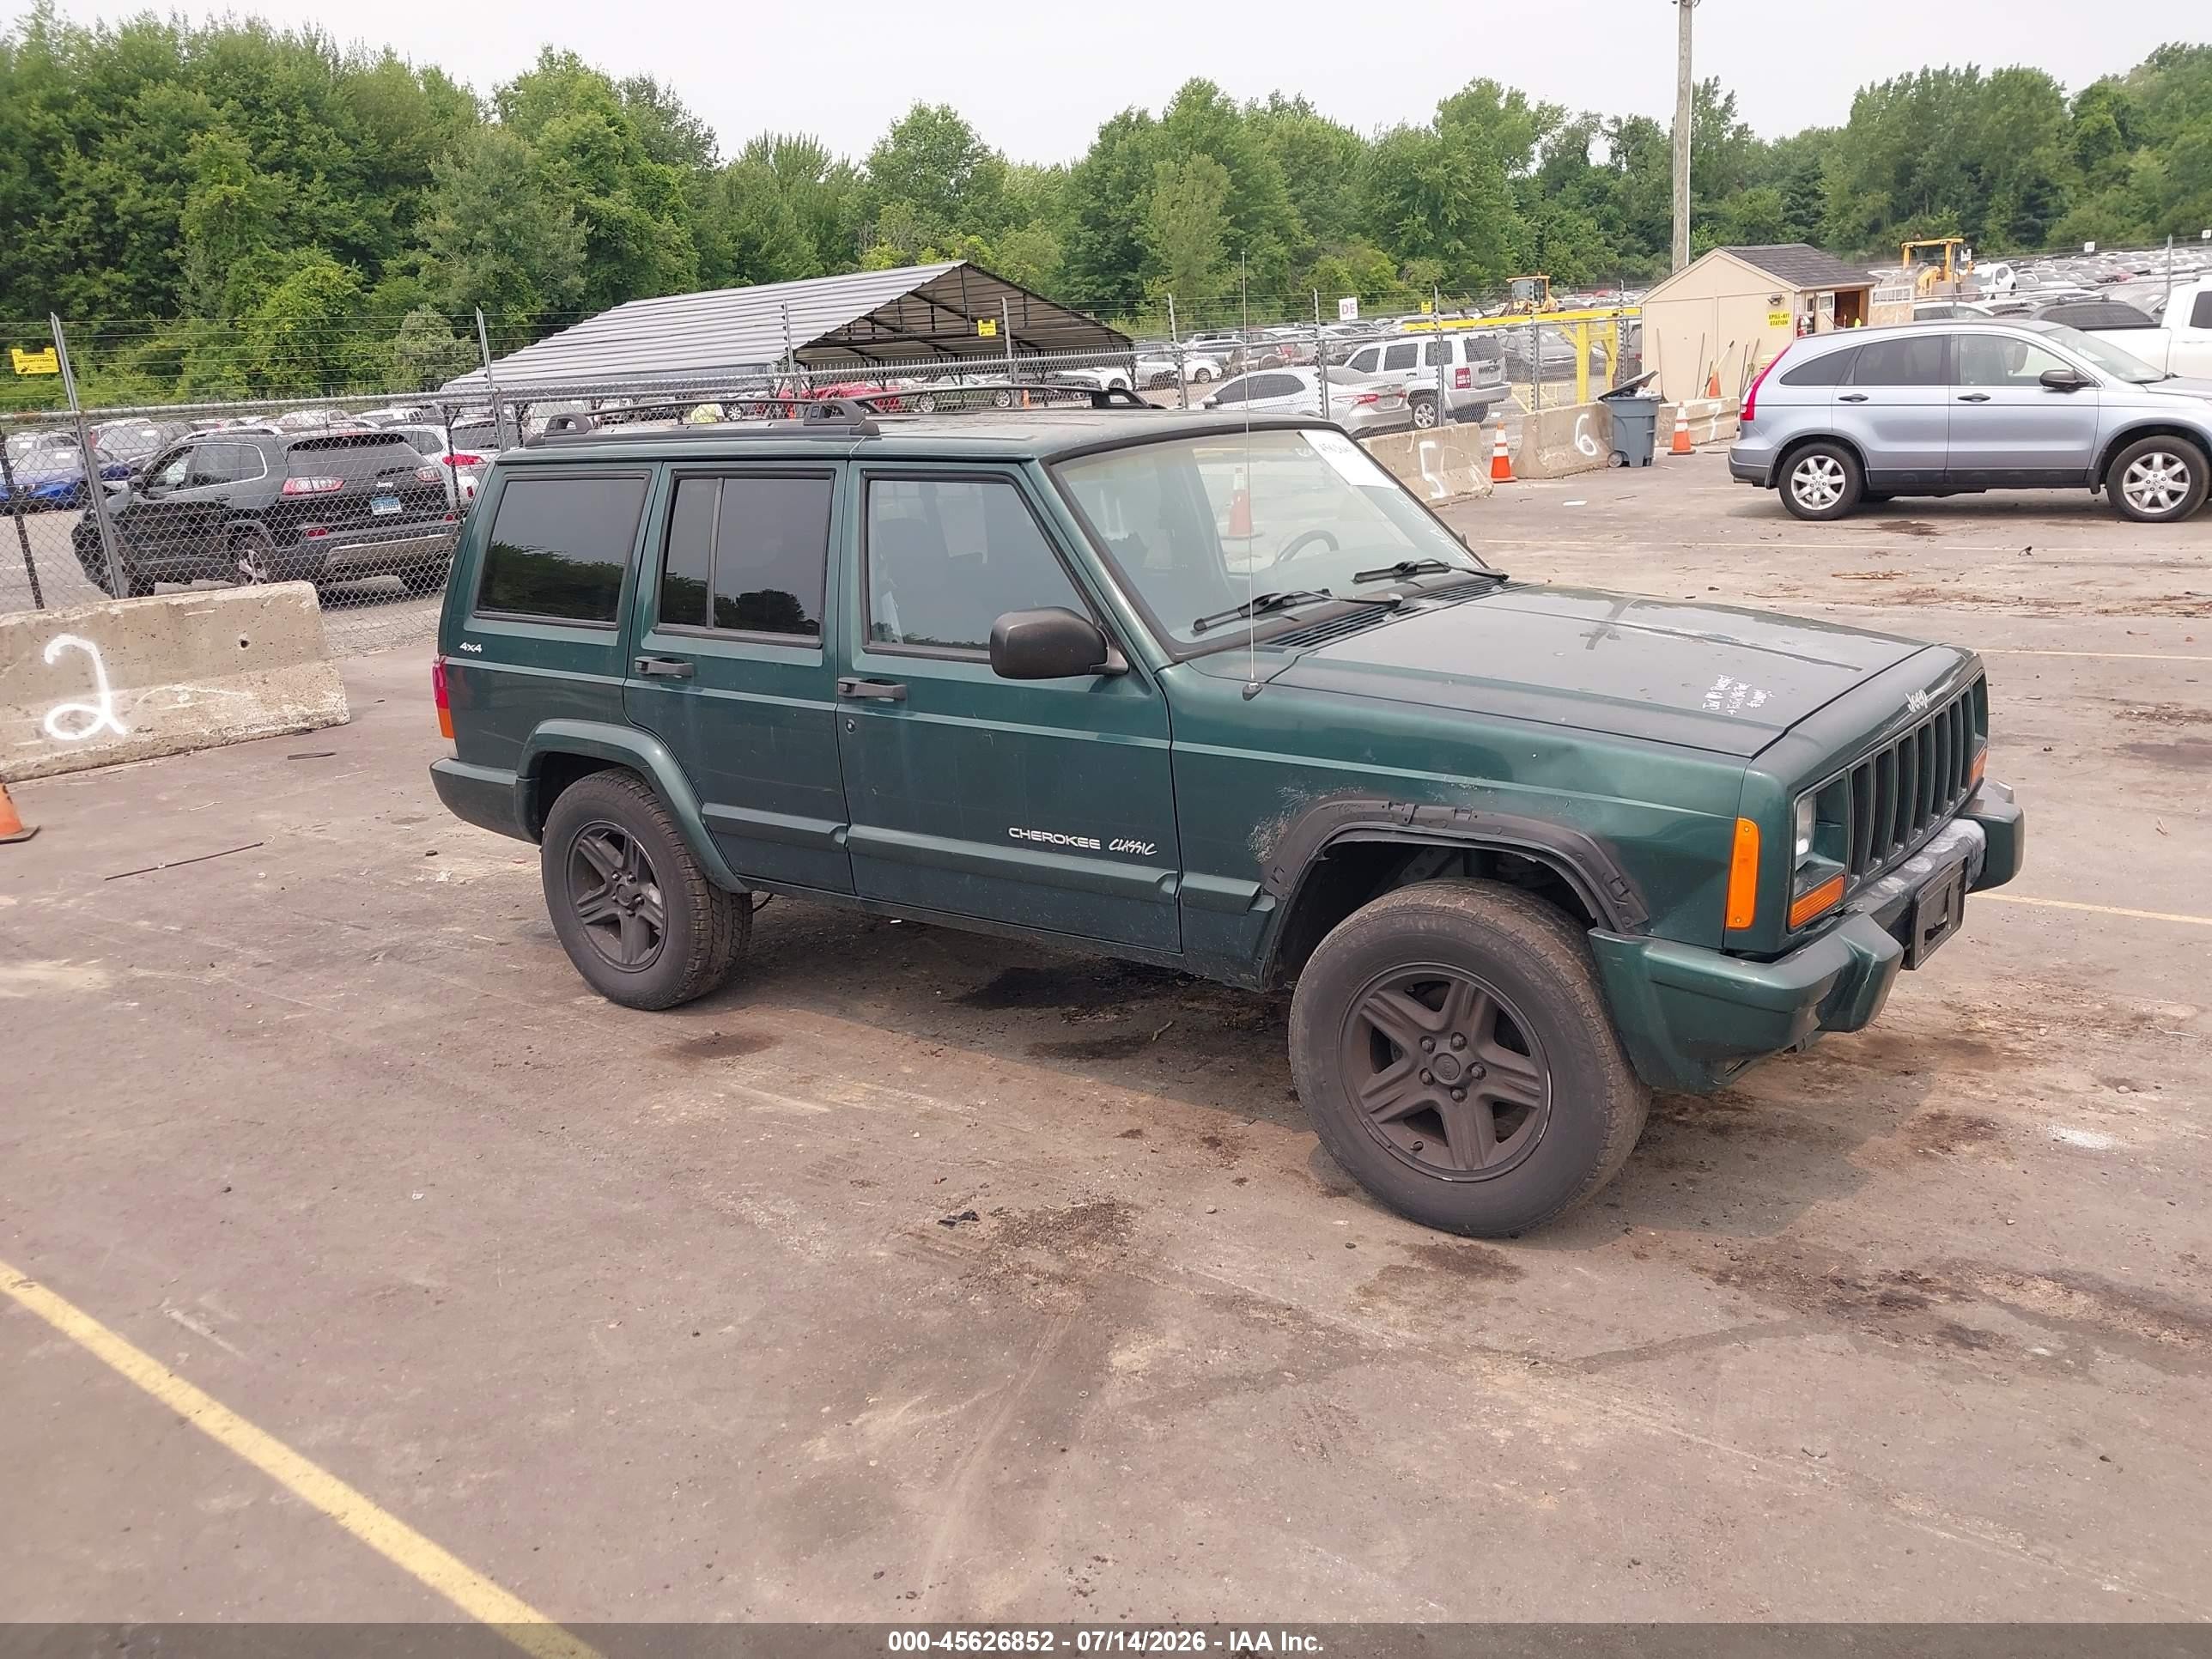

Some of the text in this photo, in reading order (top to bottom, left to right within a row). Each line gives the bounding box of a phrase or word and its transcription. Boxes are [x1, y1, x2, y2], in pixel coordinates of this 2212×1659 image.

[1576, 413, 1597, 456] 6
[45, 634, 126, 739] 2
[1905, 689, 1929, 713] Jeep
[1008, 827, 1101, 850] CHEROKEE
